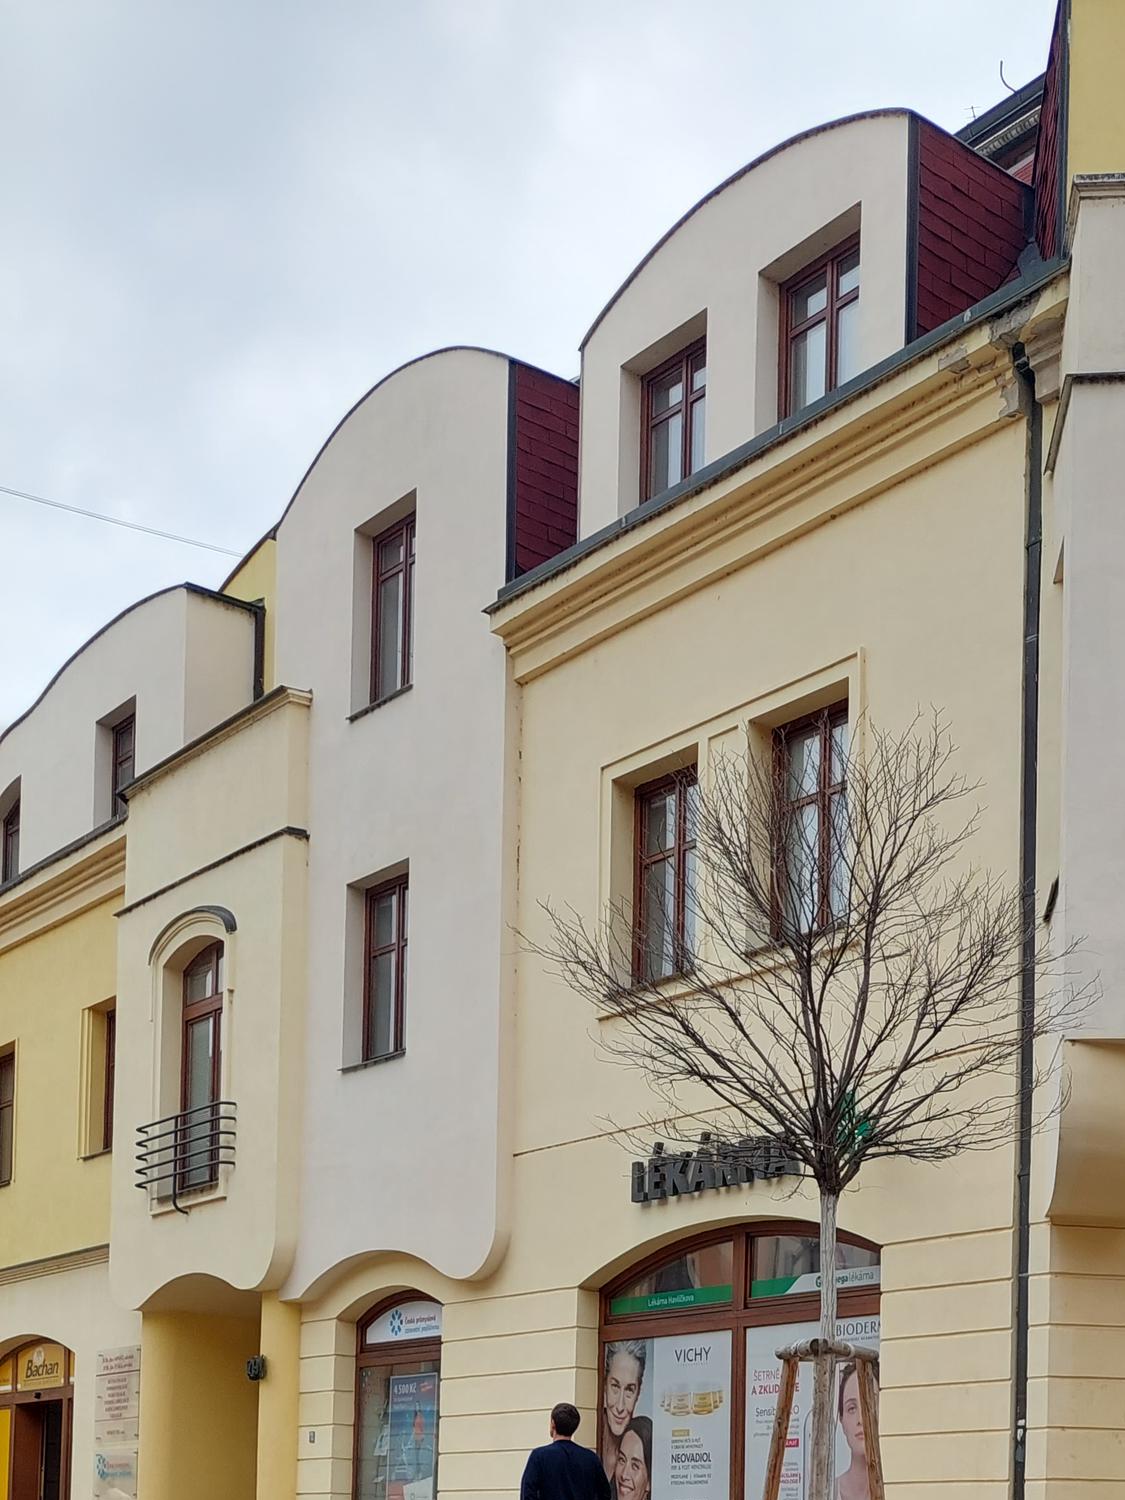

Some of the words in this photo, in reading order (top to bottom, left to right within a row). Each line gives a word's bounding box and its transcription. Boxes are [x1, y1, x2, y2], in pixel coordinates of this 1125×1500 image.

[647, 1296, 667, 1307] Lékárna
[836, 1320, 881, 1337] BIODER
[674, 1346, 712, 1363] VICHY
[25, 1360, 59, 1379] Bachan
[751, 1385, 757, 1396] A
[758, 1382, 800, 1395] ZKLIDE
[671, 1452, 712, 1464] NEOVADIOL
